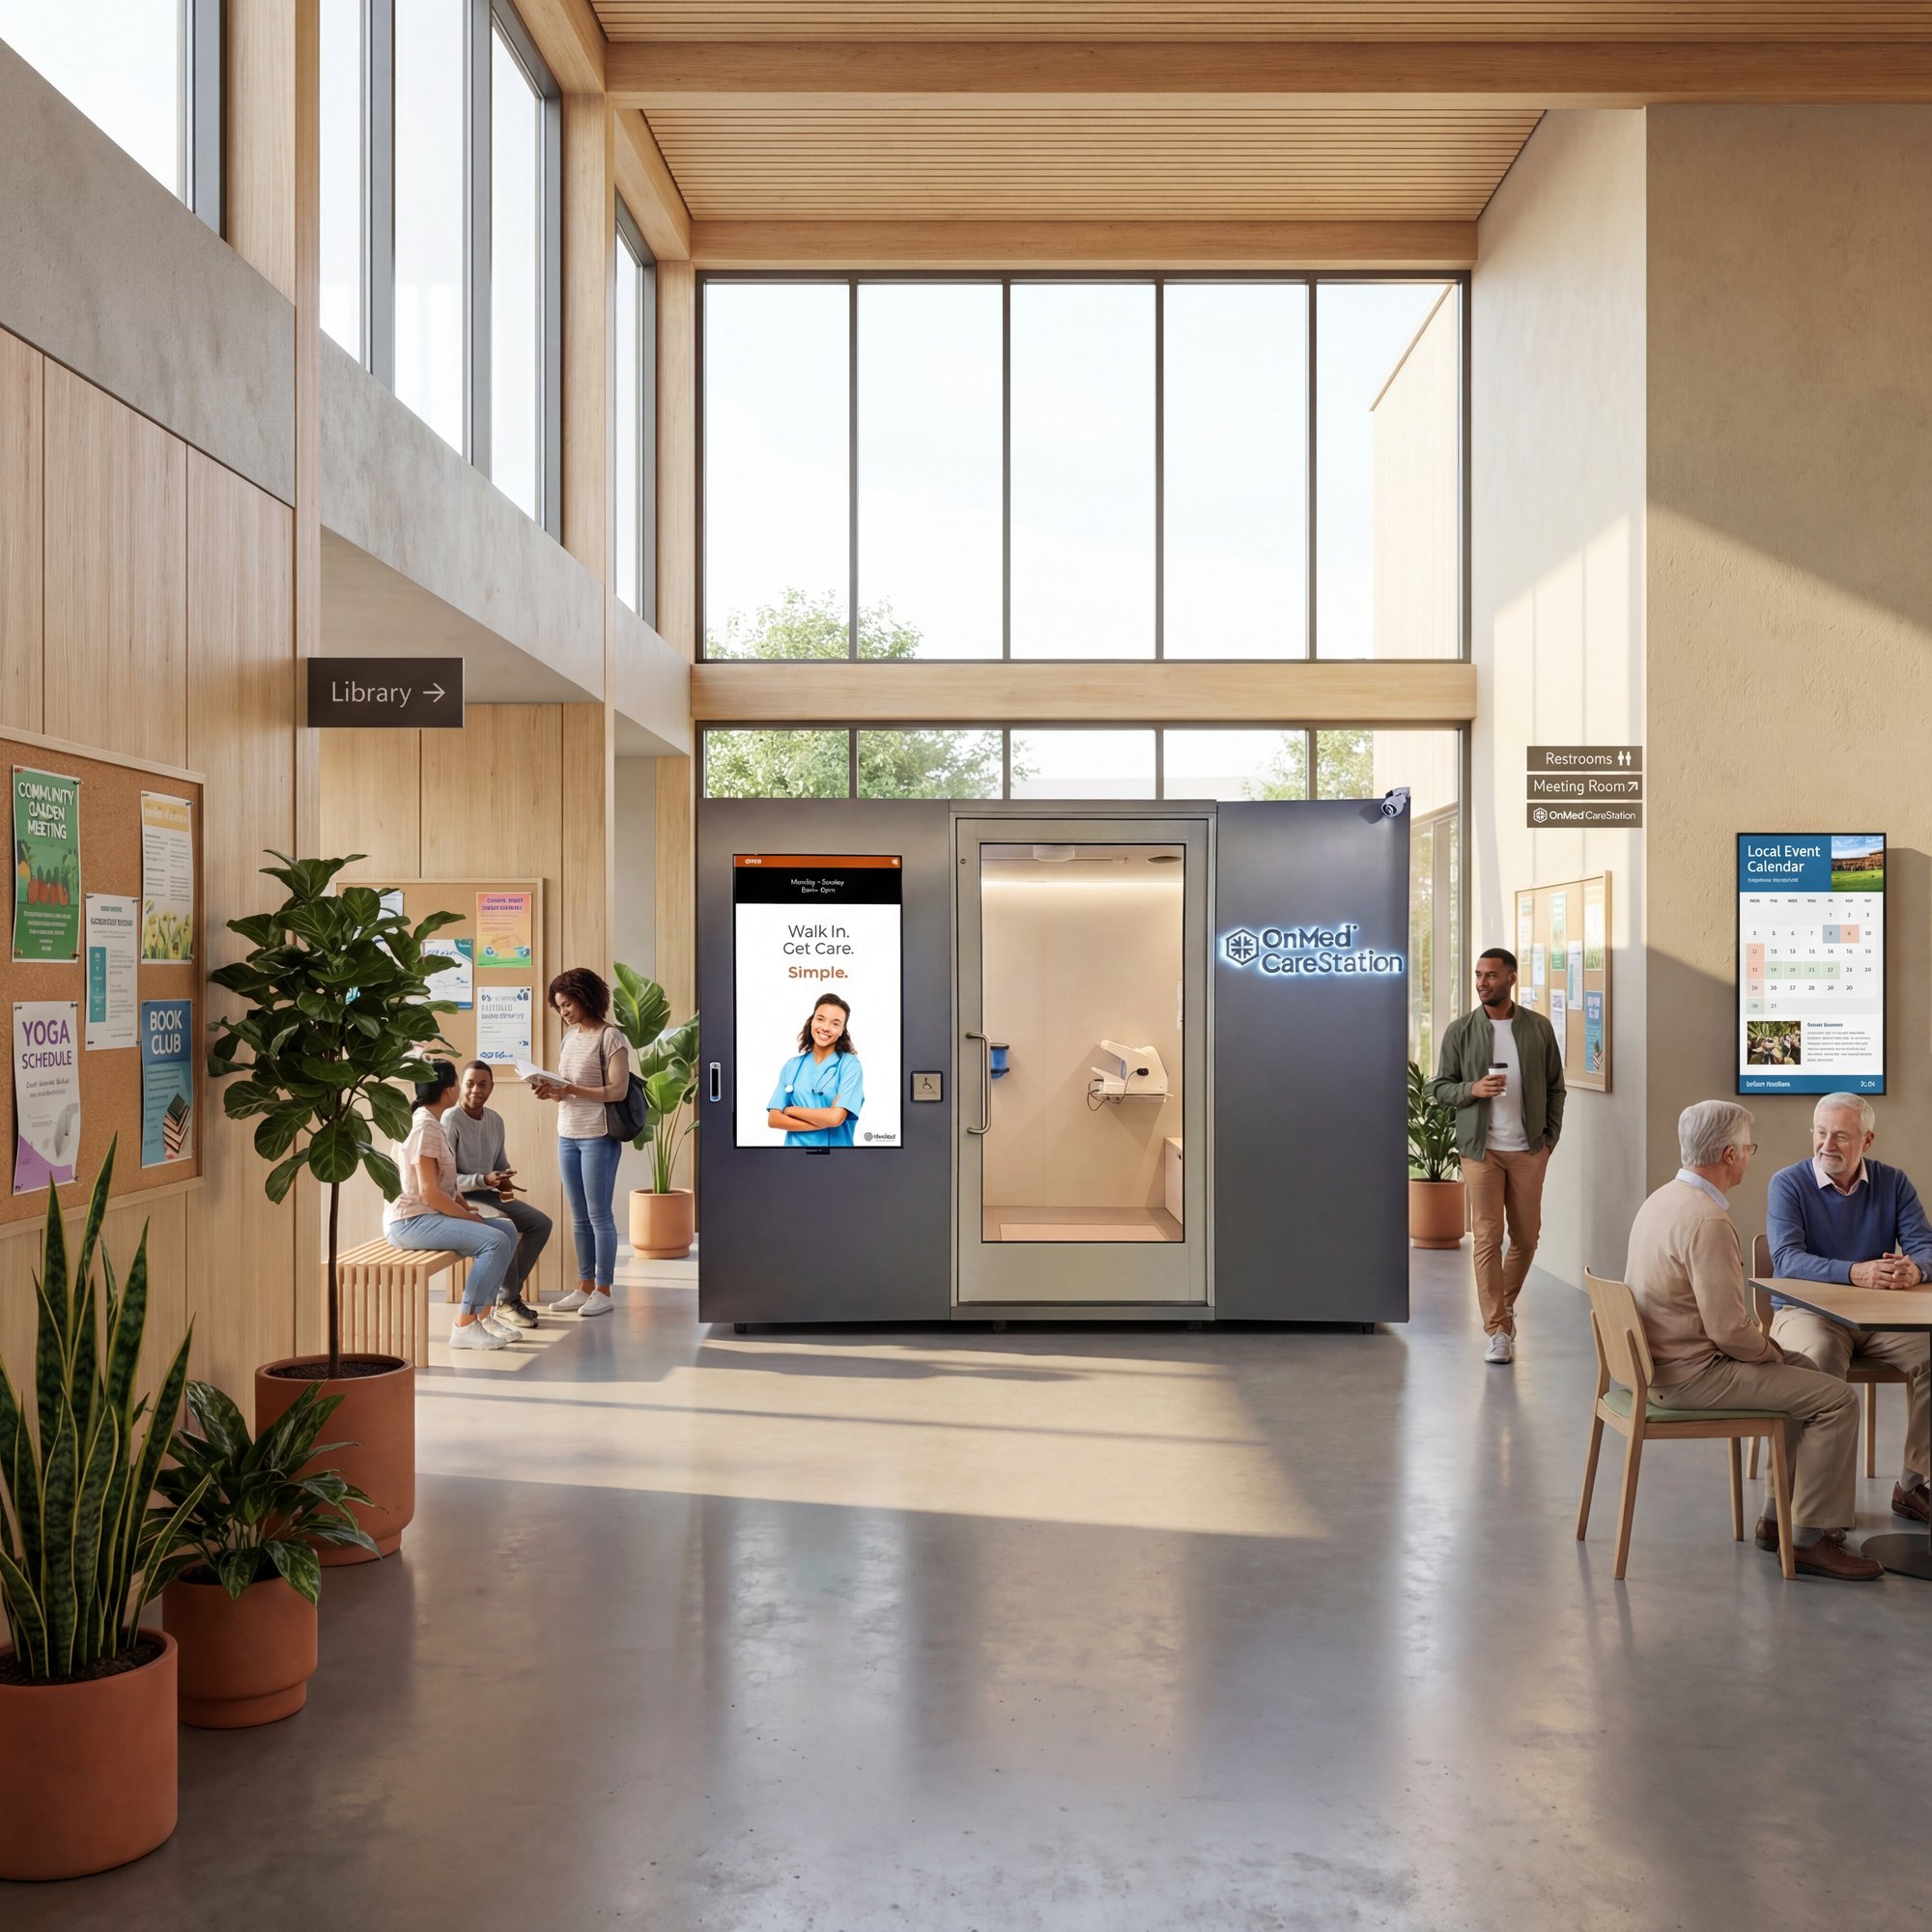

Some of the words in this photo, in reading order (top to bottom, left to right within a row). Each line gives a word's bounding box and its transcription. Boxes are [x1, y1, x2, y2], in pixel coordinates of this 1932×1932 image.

[332, 681, 412, 708] Library
[1547, 753, 1612, 764] Restrooms
[1534, 780, 1584, 795] Meeting
[1589, 780, 1625, 791] Room
[28, 819, 67, 839] MEETING
[1748, 845, 1780, 857] Local
[1785, 845, 1820, 857] Event
[1747, 861, 1804, 872] Calendar
[788, 924, 828, 938] Walk
[832, 924, 850, 938] In.
[1262, 924, 1351, 949] OnMed
[783, 942, 811, 955] Get
[815, 942, 854, 955] Care.
[1262, 950, 1403, 974] CareStation
[788, 966, 848, 981] Simple.
[150, 1009, 183, 1032] BOOK
[22, 1019, 71, 1046] YOGA
[152, 1034, 181, 1055] CLUB
[22, 1050, 71, 1069] SCHEDULE
